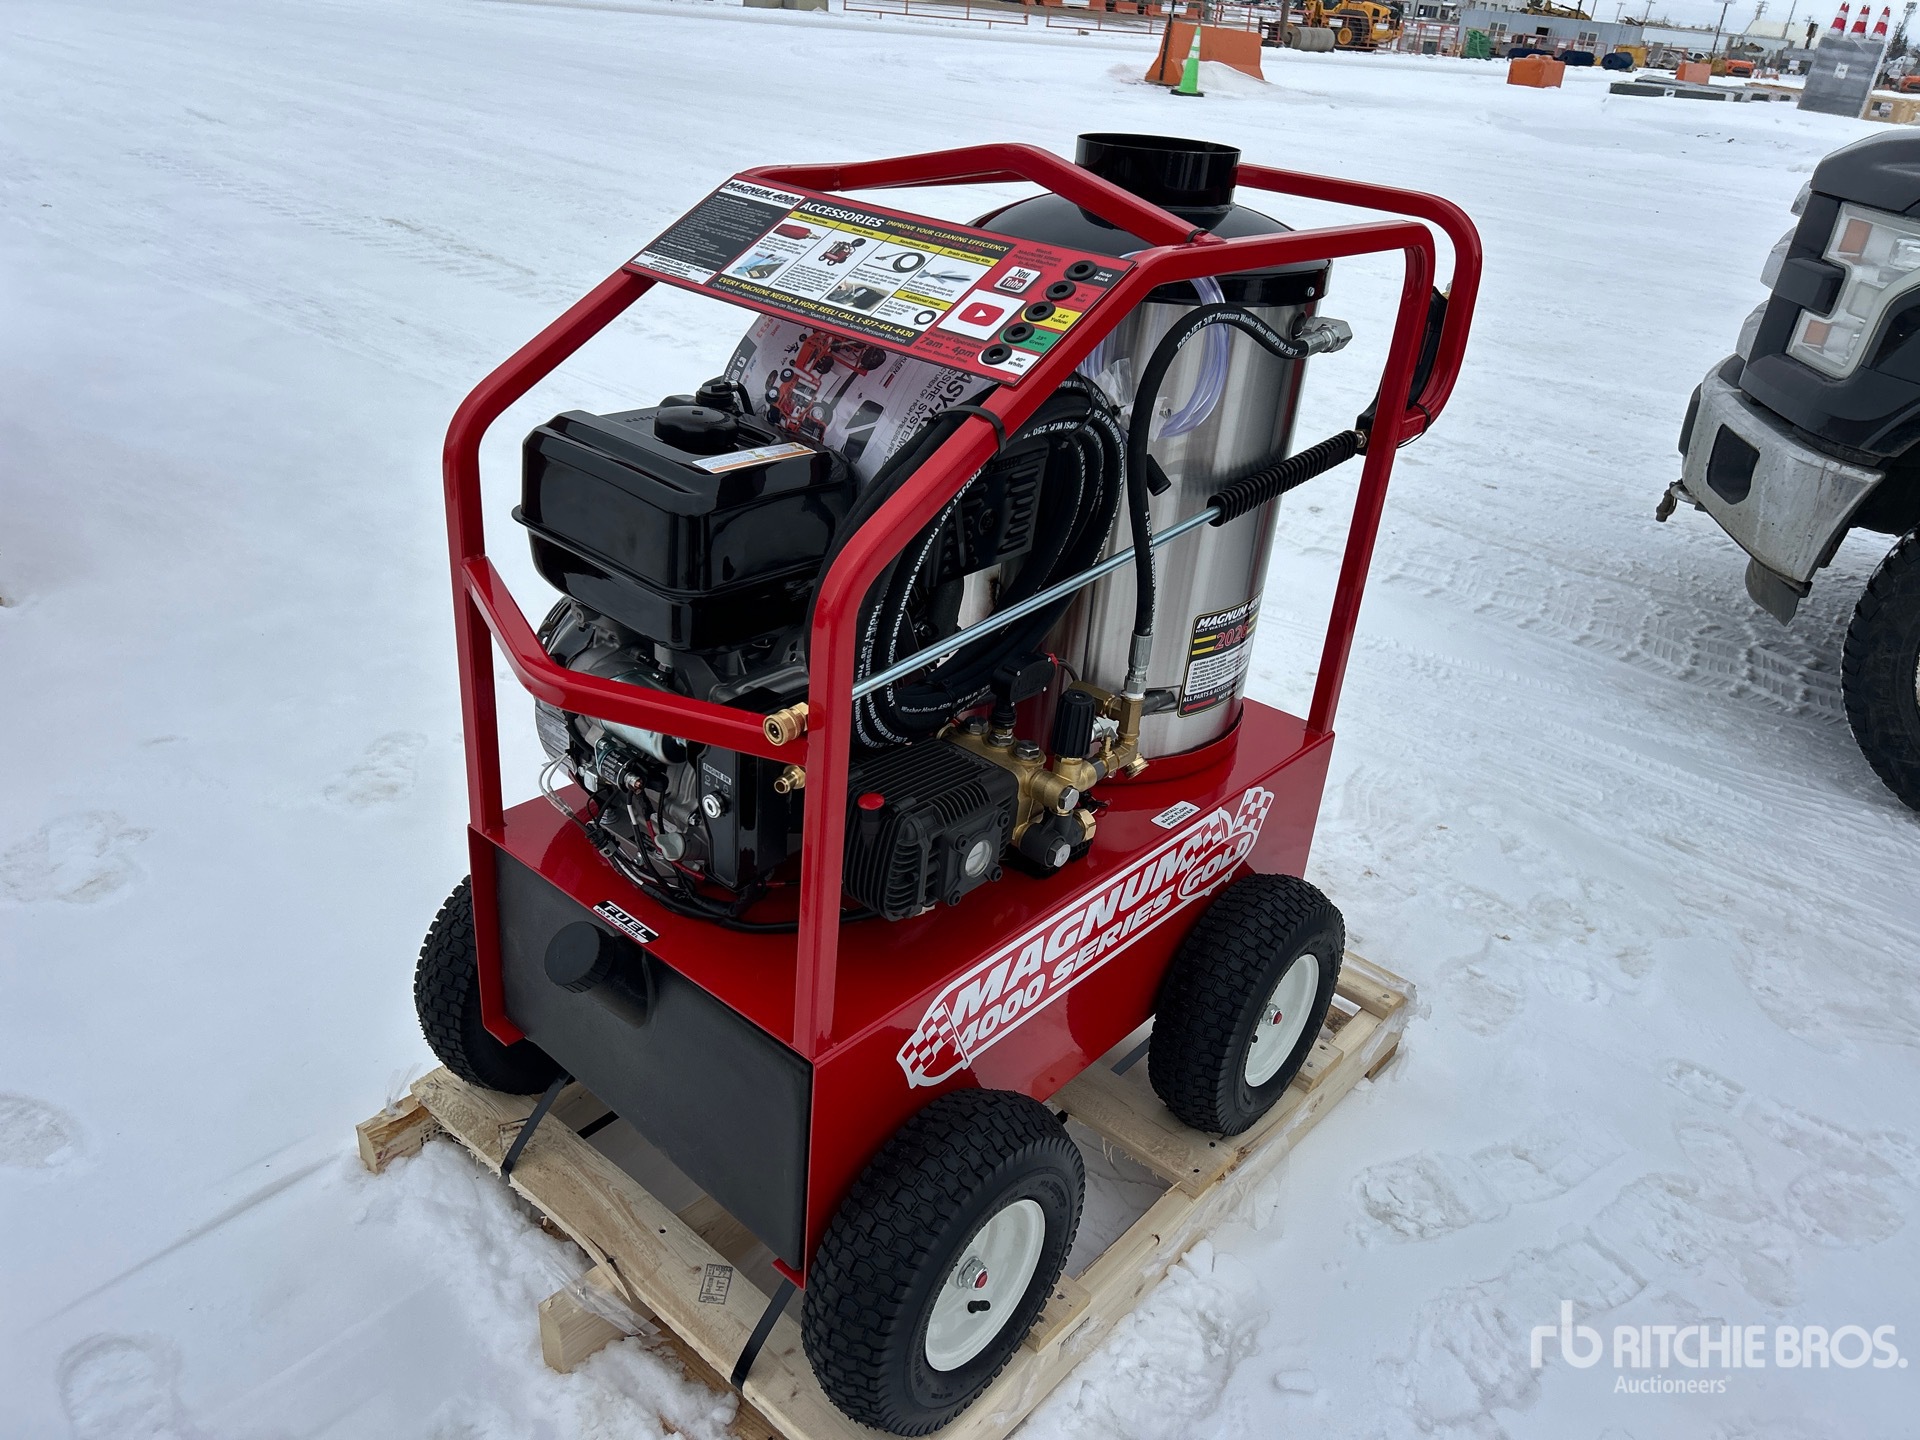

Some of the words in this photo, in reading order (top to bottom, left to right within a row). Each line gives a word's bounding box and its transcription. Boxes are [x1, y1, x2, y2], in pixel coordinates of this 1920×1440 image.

[726, 181, 773, 199] MAGNUM
[799, 202, 885, 228] ACCESSORIES
[886, 220, 916, 232] IMPROVE
[917, 224, 935, 235] YOUR
[935, 231, 968, 243] CLEANING
[966, 238, 1009, 252] EFFICIENCY
[1002, 277, 1024, 289] Tube
[1015, 268, 1030, 279] You
[718, 277, 741, 288] EVERY
[740, 283, 772, 296] MACHINE
[772, 291, 793, 303] NEEDS
[798, 299, 818, 310] HOSE
[818, 305, 838, 316] REEL!
[838, 311, 856, 322] CALL
[856, 316, 915, 338] 1-877-441-4430
[1050, 316, 1069, 325] Yellow
[920, 336, 942, 349] 7am
[952, 346, 976, 358] 4pm
[1176, 319, 1203, 351] PROJET
[1216, 312, 1241, 321] Pressure
[914, 527, 940, 573] Pressure
[1196, 604, 1249, 629] MAGNUM
[1181, 836, 1252, 897] GOLD
[604, 905, 647, 938] FUEL
[945, 840, 1205, 1027] MAGNUM
[953, 974, 1045, 1056] 4000
[1049, 883, 1175, 991] SERIES
